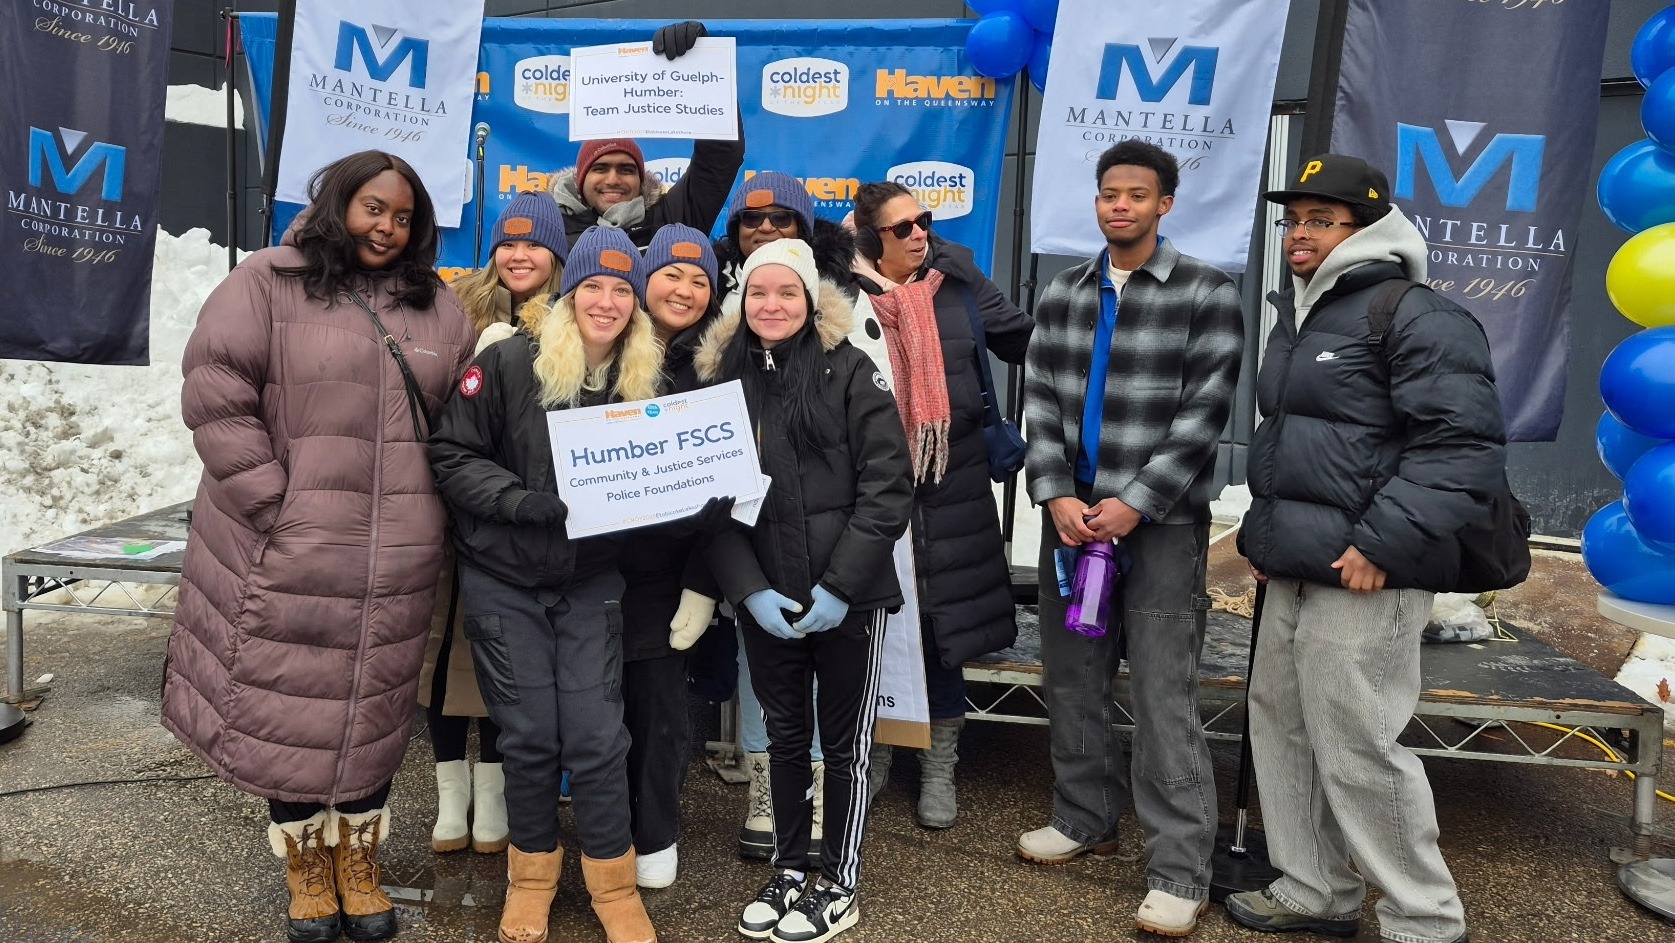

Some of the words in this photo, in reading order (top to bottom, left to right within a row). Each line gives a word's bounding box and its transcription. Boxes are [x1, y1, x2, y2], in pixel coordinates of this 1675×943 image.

[33, 0, 139, 37] CORPORATION
[34, 16, 92, 43] Since
[97, 35, 136, 54] 1946
[521, 65, 571, 81] colde
[582, 71, 648, 86] University
[652, 70, 666, 81] of
[670, 70, 725, 84] Guelph-
[770, 67, 841, 84] coldest
[876, 69, 996, 98] Haven
[308, 74, 447, 115] MANTELLA
[534, 82, 570, 102] nig
[623, 87, 683, 98] Humber:
[783, 81, 841, 105] night
[323, 97, 430, 127] CORPORATION
[583, 106, 619, 117] Team
[623, 103, 672, 114] Justice
[675, 103, 724, 116] Studies
[1066, 106, 1236, 135] MANTELLA
[326, 111, 379, 135] Since
[384, 127, 426, 143] 1946
[894, 171, 967, 188] coldest
[1299, 160, 1323, 183] P
[7, 190, 142, 231] MANTELLA
[21, 218, 125, 244] CORPORATION
[1415, 215, 1566, 252] NTELLA
[23, 234, 67, 257] Since
[71, 247, 121, 264] 1946
[1431, 250, 1541, 271] ORATION
[1463, 277, 1537, 300] 1946
[570, 439, 668, 467] Humber
[676, 421, 735, 450] FSCS
[569, 468, 638, 488] Community
[641, 467, 650, 477] &
[653, 459, 694, 475] Justice
[696, 447, 744, 466] Services
[606, 488, 641, 502] Police
[644, 474, 715, 495] Foundations
